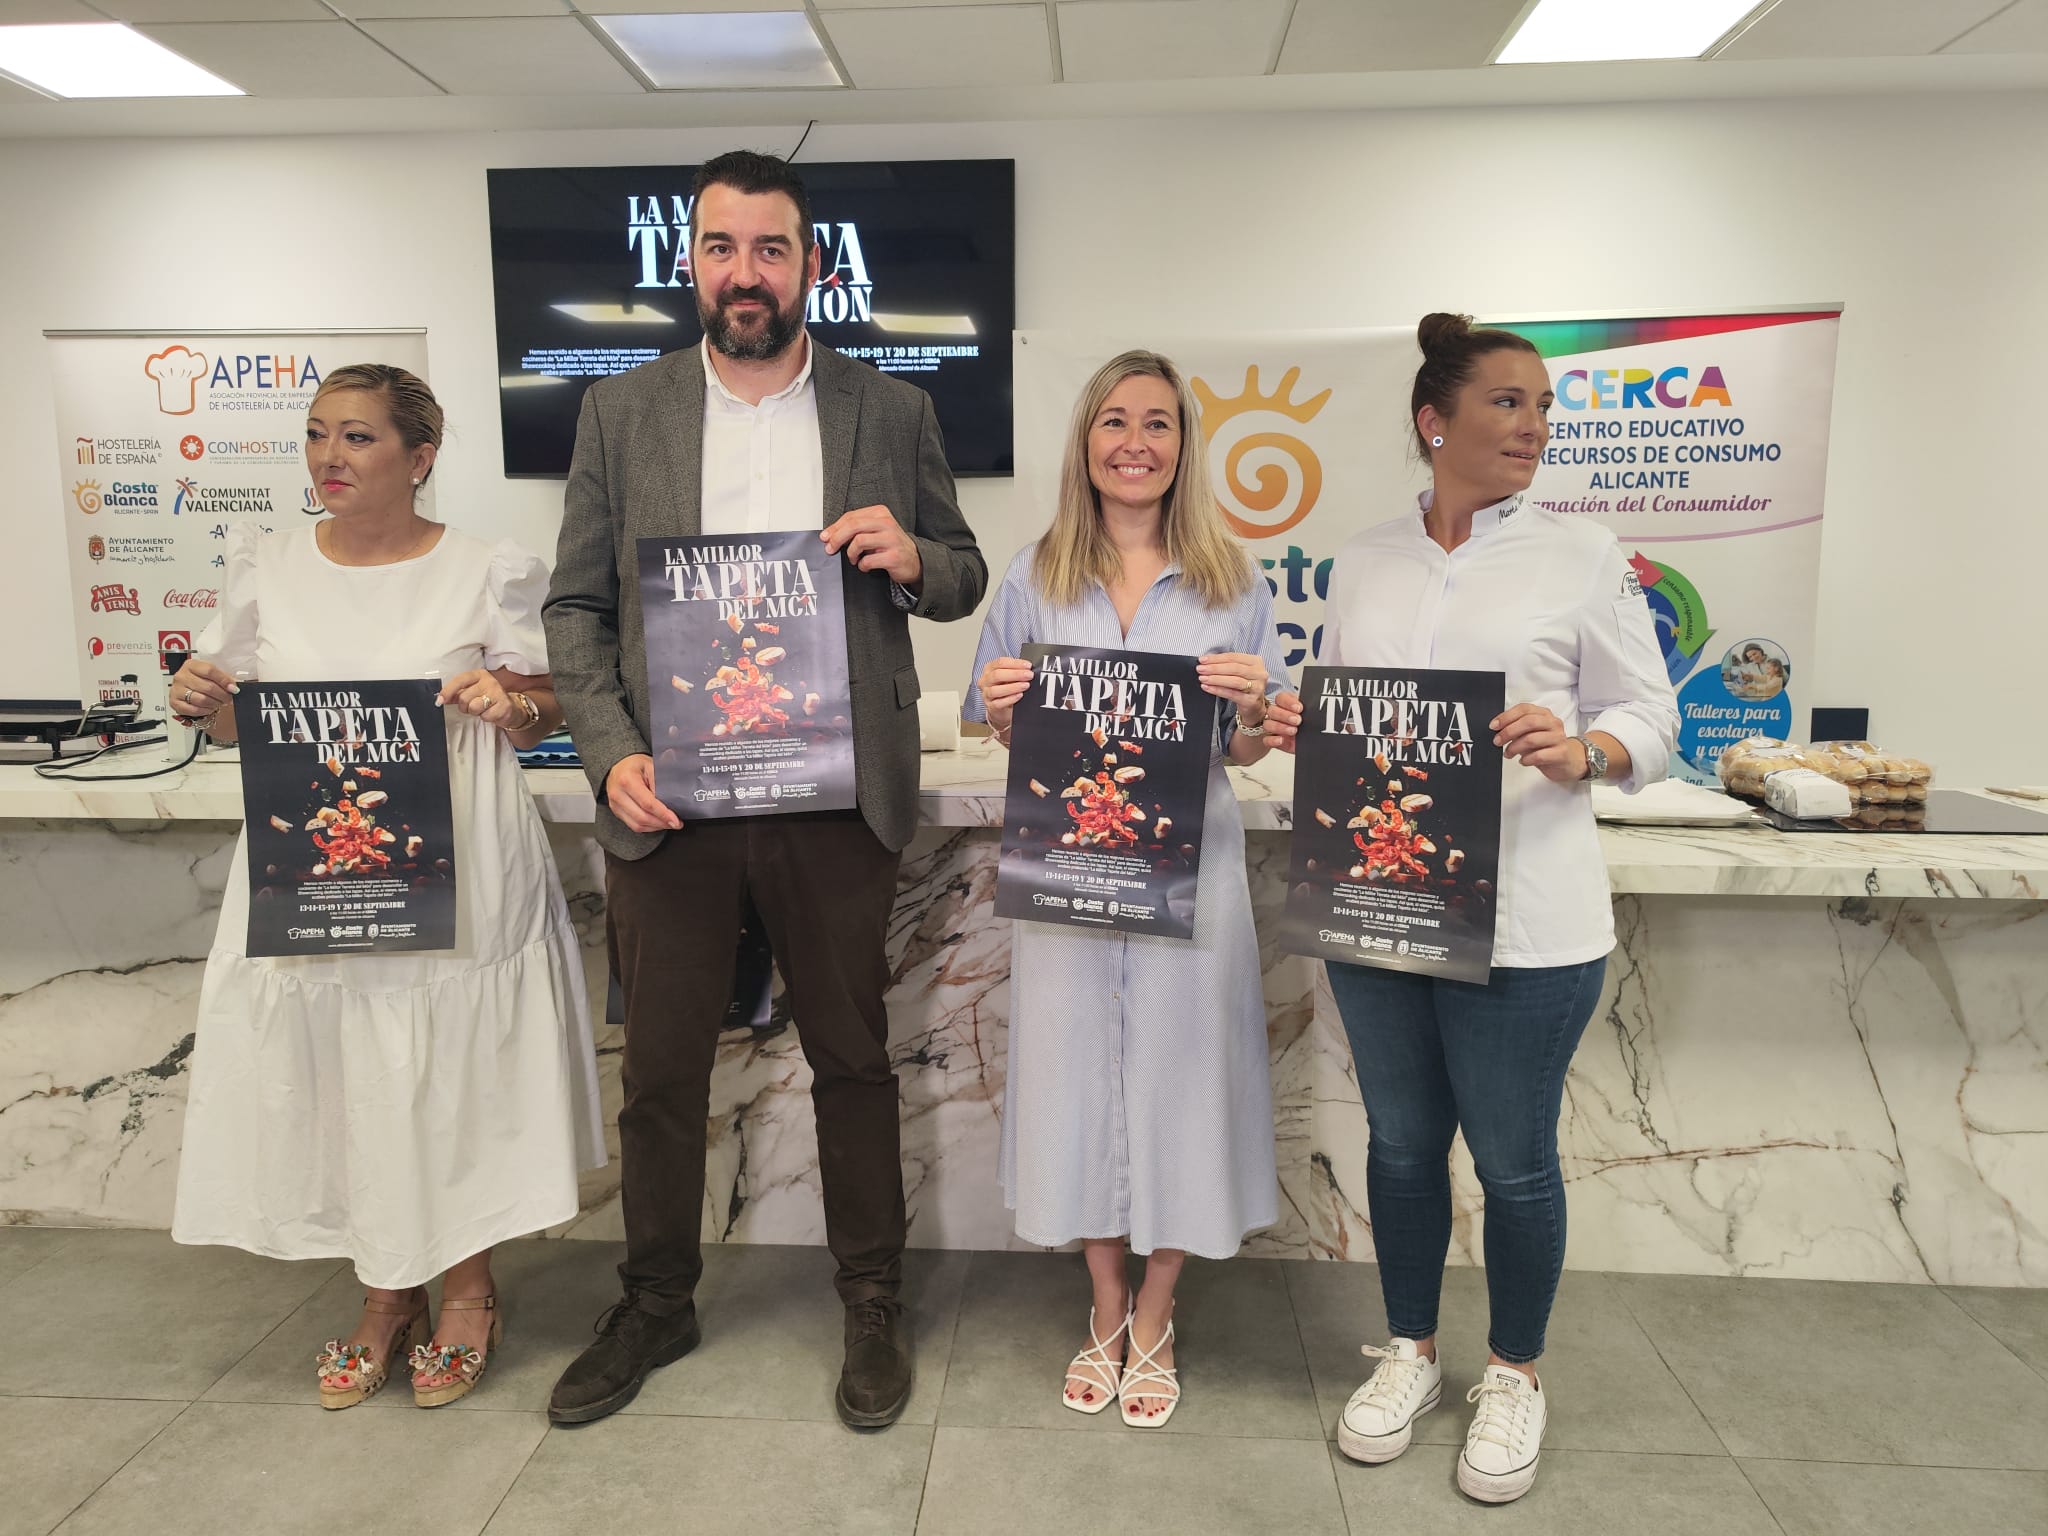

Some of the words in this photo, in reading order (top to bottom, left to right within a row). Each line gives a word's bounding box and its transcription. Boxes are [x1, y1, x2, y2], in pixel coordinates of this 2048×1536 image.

[628, 196, 664, 225] LA
[885, 347, 892, 357] Y
[894, 347, 905, 357] 20
[908, 346, 920, 357] DE
[920, 346, 979, 357] SEPTIEMBRE
[210, 354, 322, 388] APEHA
[1556, 366, 1732, 410] CERCA
[210, 402, 220, 410] DE
[223, 400, 270, 410] HOSTELERÍA
[274, 401, 284, 410] DE
[287, 401, 312, 410] ALICA
[1628, 418, 1744, 438] EDUCATIVO
[98, 437, 161, 450] HOSTELERÍA
[208, 442, 298, 454] CONHOSTUR
[98, 454, 112, 464] DE
[116, 452, 157, 464] ESPAÑA
[1644, 446, 1669, 463] DE
[1675, 444, 1781, 463] CONSUMO
[112, 482, 158, 494] Costa
[1589, 471, 1690, 490] ALICANTE
[104, 494, 158, 506] Blanca
[200, 488, 271, 498] COMUNITAT
[186, 500, 273, 512] VALENCIANA
[1616, 496, 1646, 512] del
[1652, 495, 1772, 512] Consumidor
[664, 548, 686, 565] LA
[691, 544, 763, 564] MILLOR
[665, 560, 818, 602] TAPETA
[98, 586, 120, 600] ANIS
[106, 600, 135, 610] TENIS
[717, 599, 760, 620] DEL
[107, 642, 153, 651] prevenzis
[1042, 655, 1062, 673] LA
[1068, 658, 1138, 680] MILLOR
[1039, 673, 1187, 721] TAPETA
[1322, 678, 1342, 695] LA
[1347, 679, 1418, 700] MILLOR
[258, 692, 281, 708] LA
[287, 692, 362, 708] MILLOR
[1319, 696, 1473, 743] TAPETA
[1684, 703, 1740, 720] Talleres
[1741, 708, 1781, 724] para
[261, 707, 420, 743] TAPETA
[1084, 712, 1125, 736] DEL
[1698, 724, 1764, 738] escolares
[316, 743, 360, 763] DEL
[1365, 737, 1407, 761] DEL
[764, 761, 805, 769] SEPTIEMBRE
[1105, 878, 1147, 889] SEPTIEMBRE
[364, 901, 406, 909] SEPTIEMBRE
[1396, 915, 1440, 928] SEPTIEMBRE
[1331, 932, 1355, 941] APEHA
